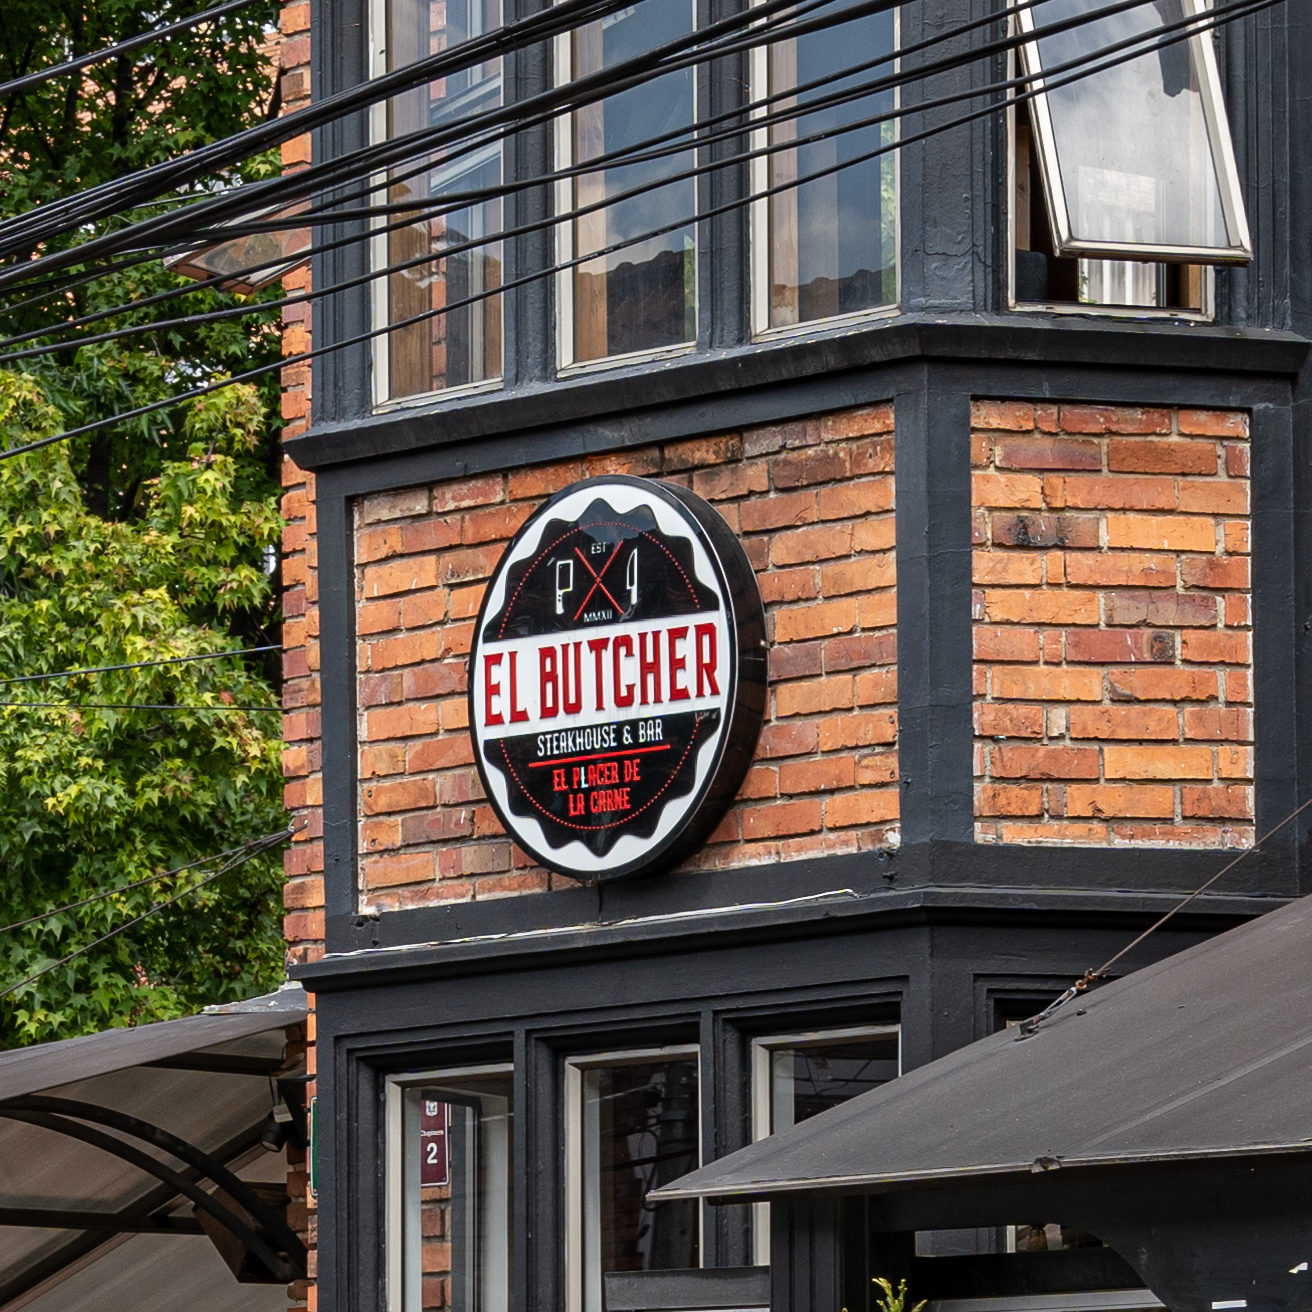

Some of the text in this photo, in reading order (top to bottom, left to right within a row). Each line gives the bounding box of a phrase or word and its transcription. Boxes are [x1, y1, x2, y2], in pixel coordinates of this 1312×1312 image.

[591, 541, 606, 554] EST
[584, 609, 613, 623] MMXII
[483, 622, 721, 727] EL BUTCHER
[537, 719, 664, 757] STEAKHOUSE & BAR
[552, 758, 641, 791] EL PLACER DE
[568, 787, 631, 816] LA CARNE
